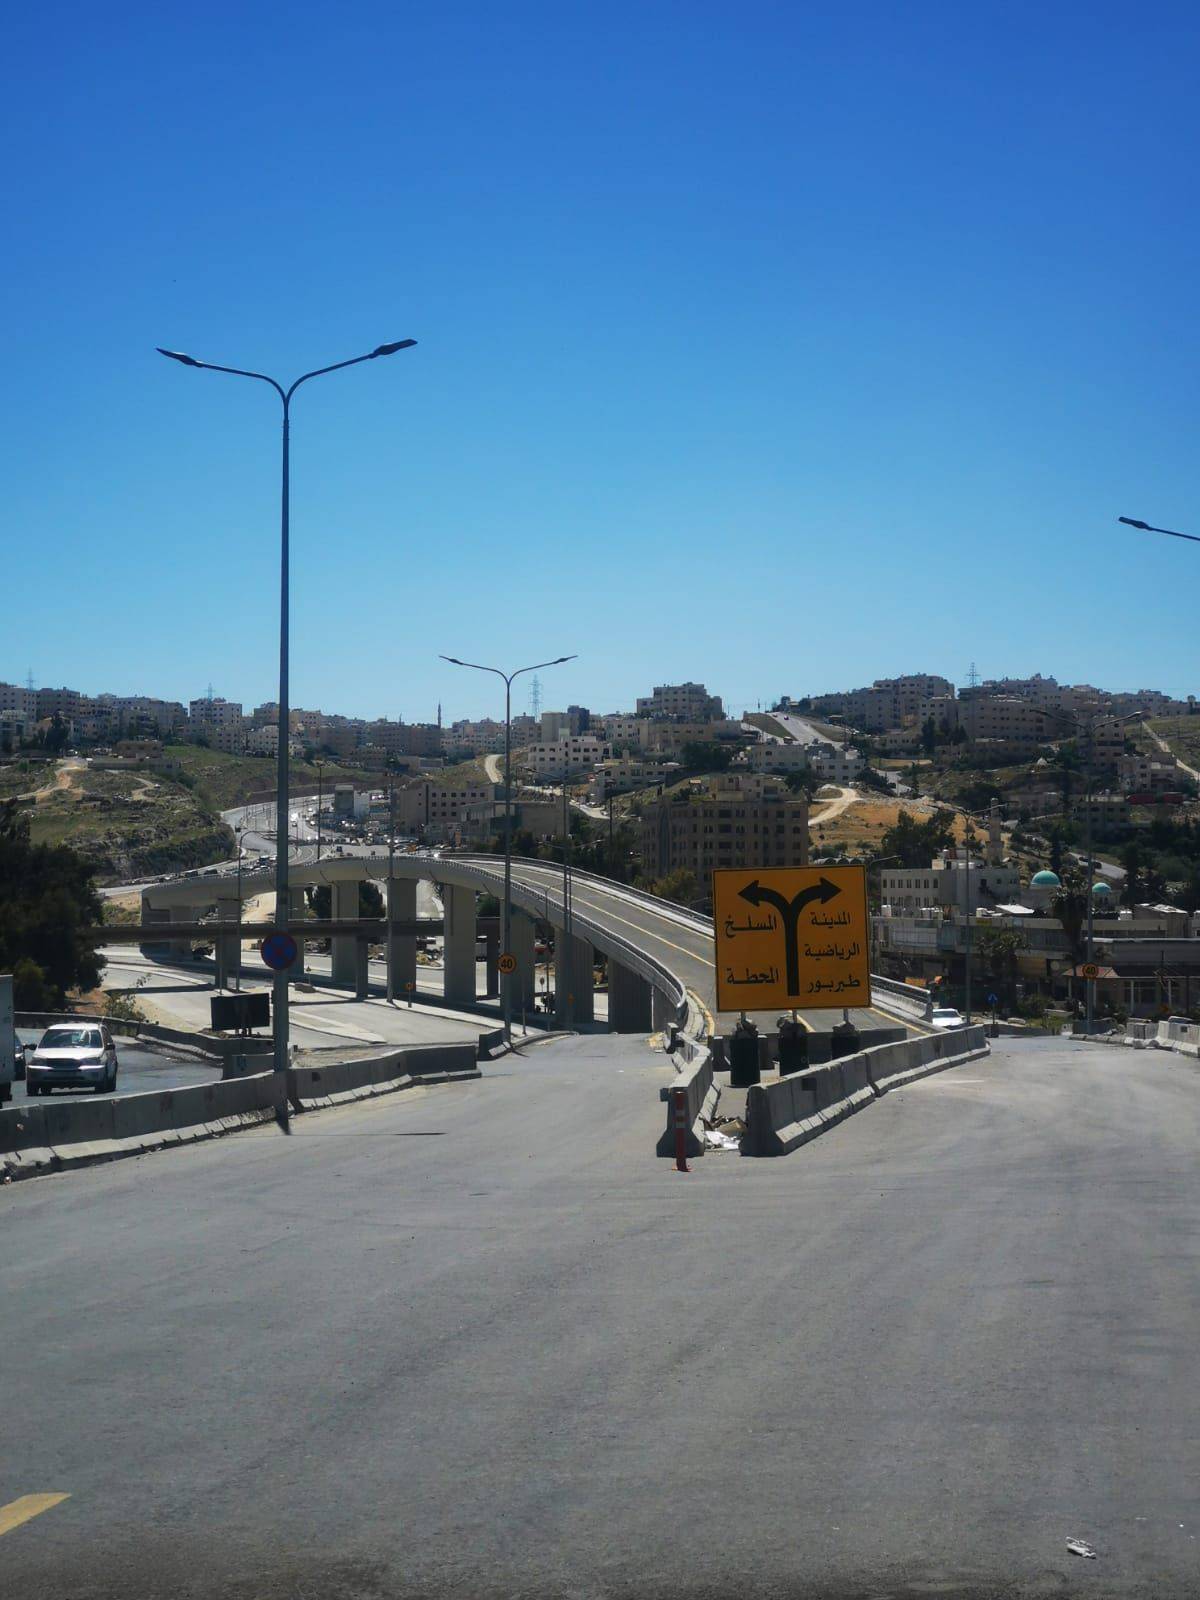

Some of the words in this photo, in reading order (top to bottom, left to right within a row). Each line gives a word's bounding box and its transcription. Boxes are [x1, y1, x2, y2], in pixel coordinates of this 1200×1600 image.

[724, 913, 777, 939] المسلخ
[811, 911, 851, 928] المدينة
[804, 942, 860, 961] الرياضية
[501, 958, 513, 969] 40
[726, 966, 779, 985] المحطة
